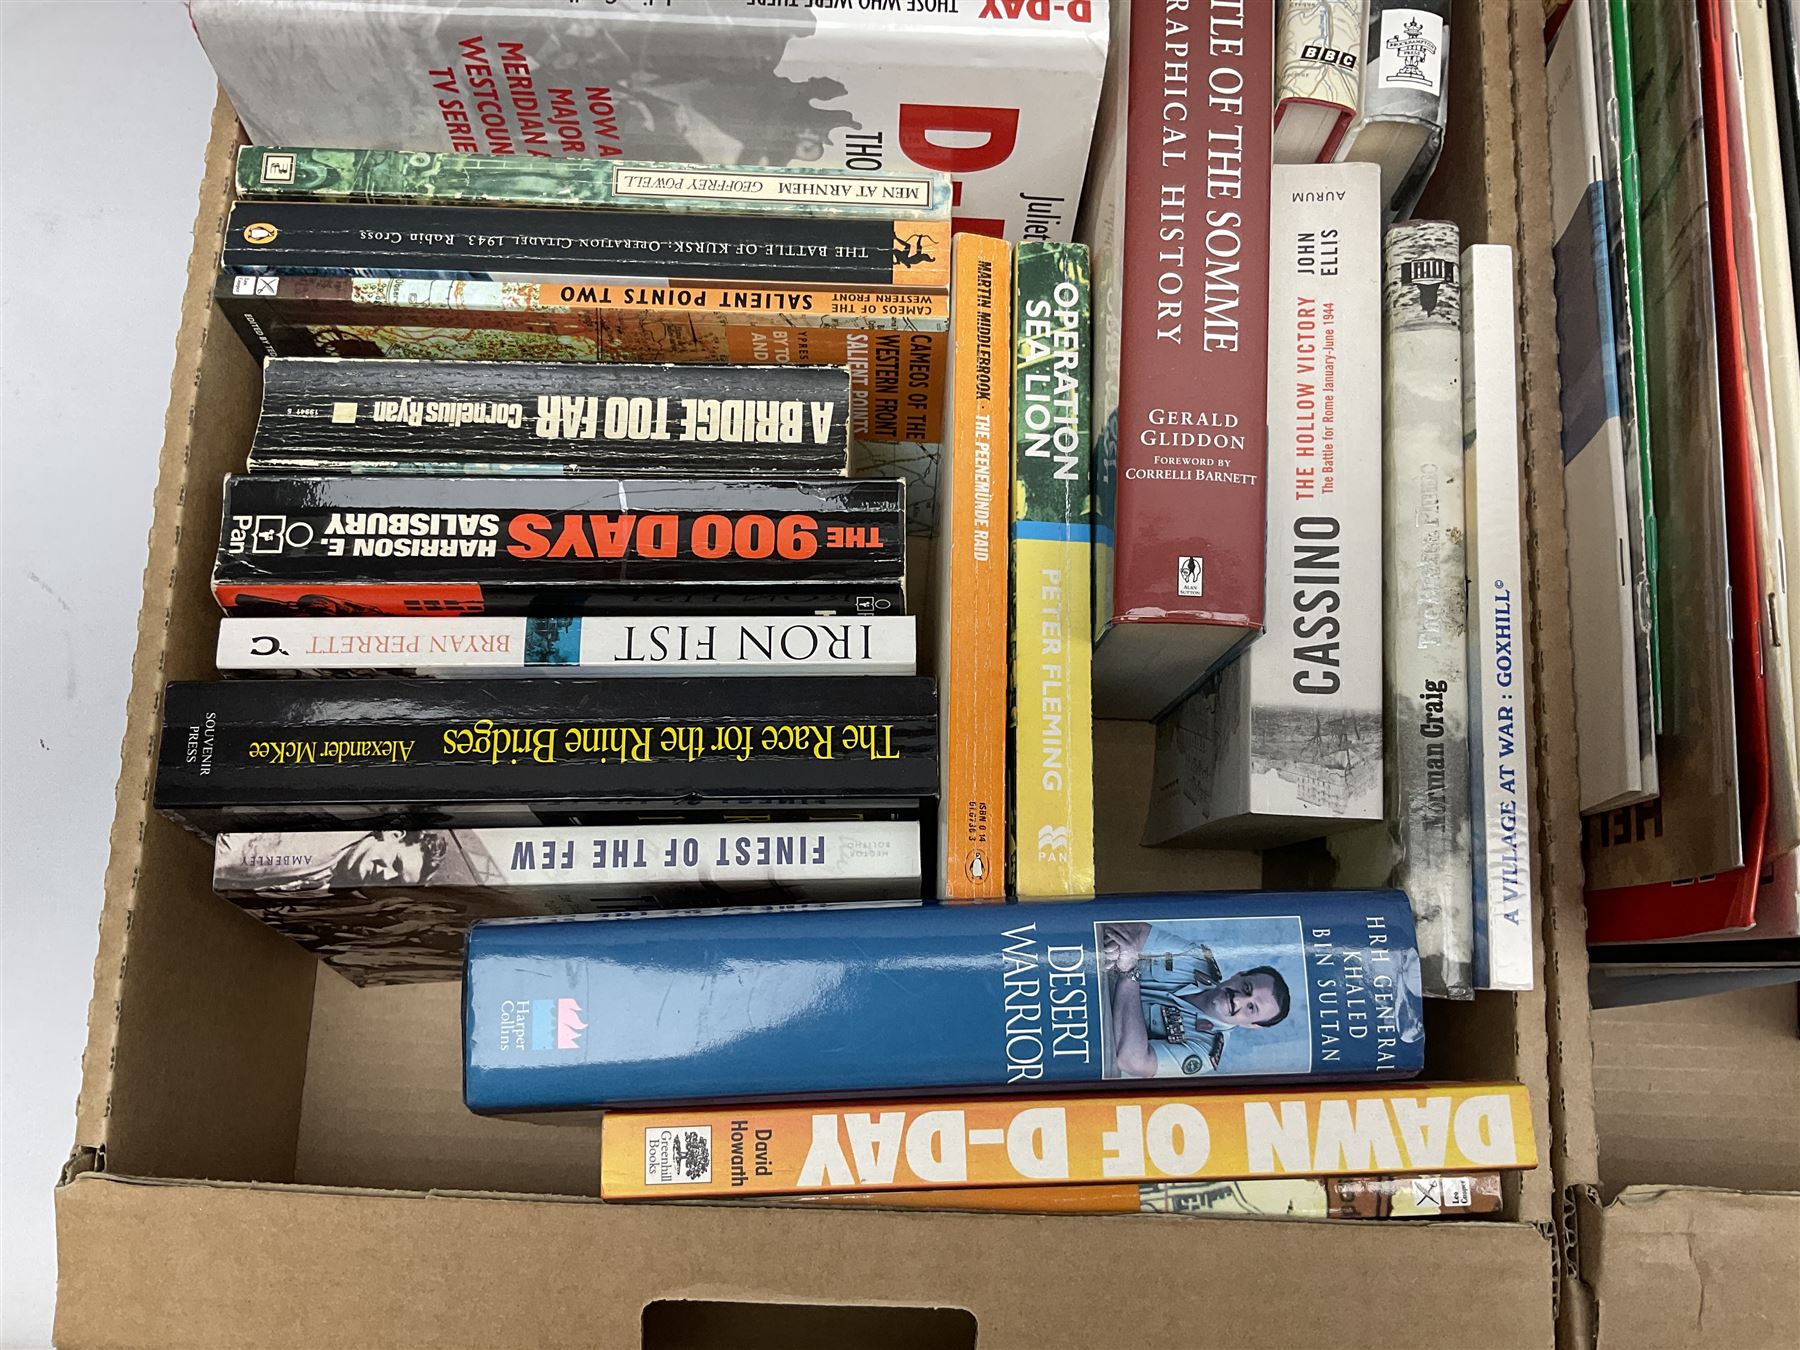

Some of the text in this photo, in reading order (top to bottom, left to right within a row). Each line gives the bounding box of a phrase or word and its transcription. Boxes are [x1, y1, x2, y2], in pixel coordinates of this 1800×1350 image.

[906, 0, 958, 13] THOSE
[978, 0, 1091, 23] D-DAY
[429, 67, 459, 94] TV
[1302, 47, 1355, 68] BBC
[498, 42, 548, 144] MERIDIAN
[1208, 67, 1243, 116] OF
[547, 88, 585, 153] MAJOR
[585, 87, 623, 158] NOW A
[1207, 125, 1242, 199] THE
[624, 175, 919, 199] MEN AT ARNHEM GEOFFREY POWELL
[1292, 191, 1346, 203] AURUM
[359, 229, 868, 258] THE BATTLE OF KURSK: OPERATION CITADEL 1943 Robin Cross
[1156, 184, 1185, 345] HISTORY
[1297, 232, 1315, 274] JOHN
[1321, 229, 1338, 276] ELLIS
[560, 286, 813, 310] SALIENT POINTS TWO
[831, 293, 932, 304] WESTERN FRONT
[978, 260, 992, 309] MARTIN
[1203, 210, 1241, 352] SOMME
[244, 313, 264, 336] EDITED
[258, 335, 270, 346] BY
[832, 304, 932, 315] CAMEOS OF THE
[751, 332, 769, 362] AND
[772, 331, 788, 345] BY
[797, 331, 809, 360] YPRES
[846, 333, 869, 386] SALIENT
[875, 334, 900, 438] WESTERN FRONT
[905, 334, 933, 440] CAMEOS OF THE
[1024, 299, 1051, 458] SEA LION
[1053, 283, 1079, 480] OPERATION
[1296, 296, 1316, 500] THE HOLLOW VICTORY
[1321, 302, 1337, 494] The Battle for Rome January-June 1944
[373, 397, 523, 429] Cornelius Ryan
[536, 395, 834, 444] A BRIDGE TOO FAR
[975, 414, 990, 440] THE
[1148, 409, 1239, 428] GERALD
[1140, 430, 1245, 450] GLIDDON
[1154, 455, 1231, 468] FOREWORD BY
[973, 442, 991, 531] PEENEMÜNDE
[1125, 468, 1257, 485] CORRELLI BARNETT
[228, 515, 253, 555] Pan
[324, 513, 500, 536] SALISBURY
[506, 513, 884, 560] THE 900 DAYS
[973, 533, 989, 562] RAID
[320, 538, 497, 558] HARRISON E.
[1292, 516, 1341, 695] CASSINO
[305, 634, 511, 655] BRYAN PERRETT
[614, 624, 872, 662] IRON FIST
[1040, 568, 1063, 792] PETER FLEMING
[186, 725, 199, 763] PRESS
[199, 712, 216, 776] SOUVENIR
[249, 739, 415, 764] Alexander McKee
[443, 719, 900, 765] The Race for the Rhine Bridges
[1498, 704, 1514, 758] WAR
[1420, 678, 1448, 834] Norman Craig
[1499, 764, 1516, 794] AT
[978, 801, 987, 822] ISBN
[240, 854, 313, 867] AMBERLEY
[510, 836, 825, 871] FINEST OF THE FEW
[1038, 851, 1067, 863] PAN
[1500, 800, 1518, 902] VILLAGE
[1502, 909, 1519, 926] A
[1000, 921, 1044, 1084] WARRIOR
[1047, 943, 1089, 1064] DESERT
[1311, 927, 1340, 1064] BIN SULTAN
[1343, 950, 1368, 1040] KHALED
[501, 999, 514, 1051] Collins
[516, 999, 530, 1051] Harper
[1374, 975, 1396, 1073] GENERAL
[649, 1139, 660, 1174] Books
[660, 1130, 672, 1182] Greenhill
[731, 1120, 748, 1187] Howarth
[755, 1129, 773, 1176] David
[796, 1094, 1517, 1187] DAWN OF D-DAY
